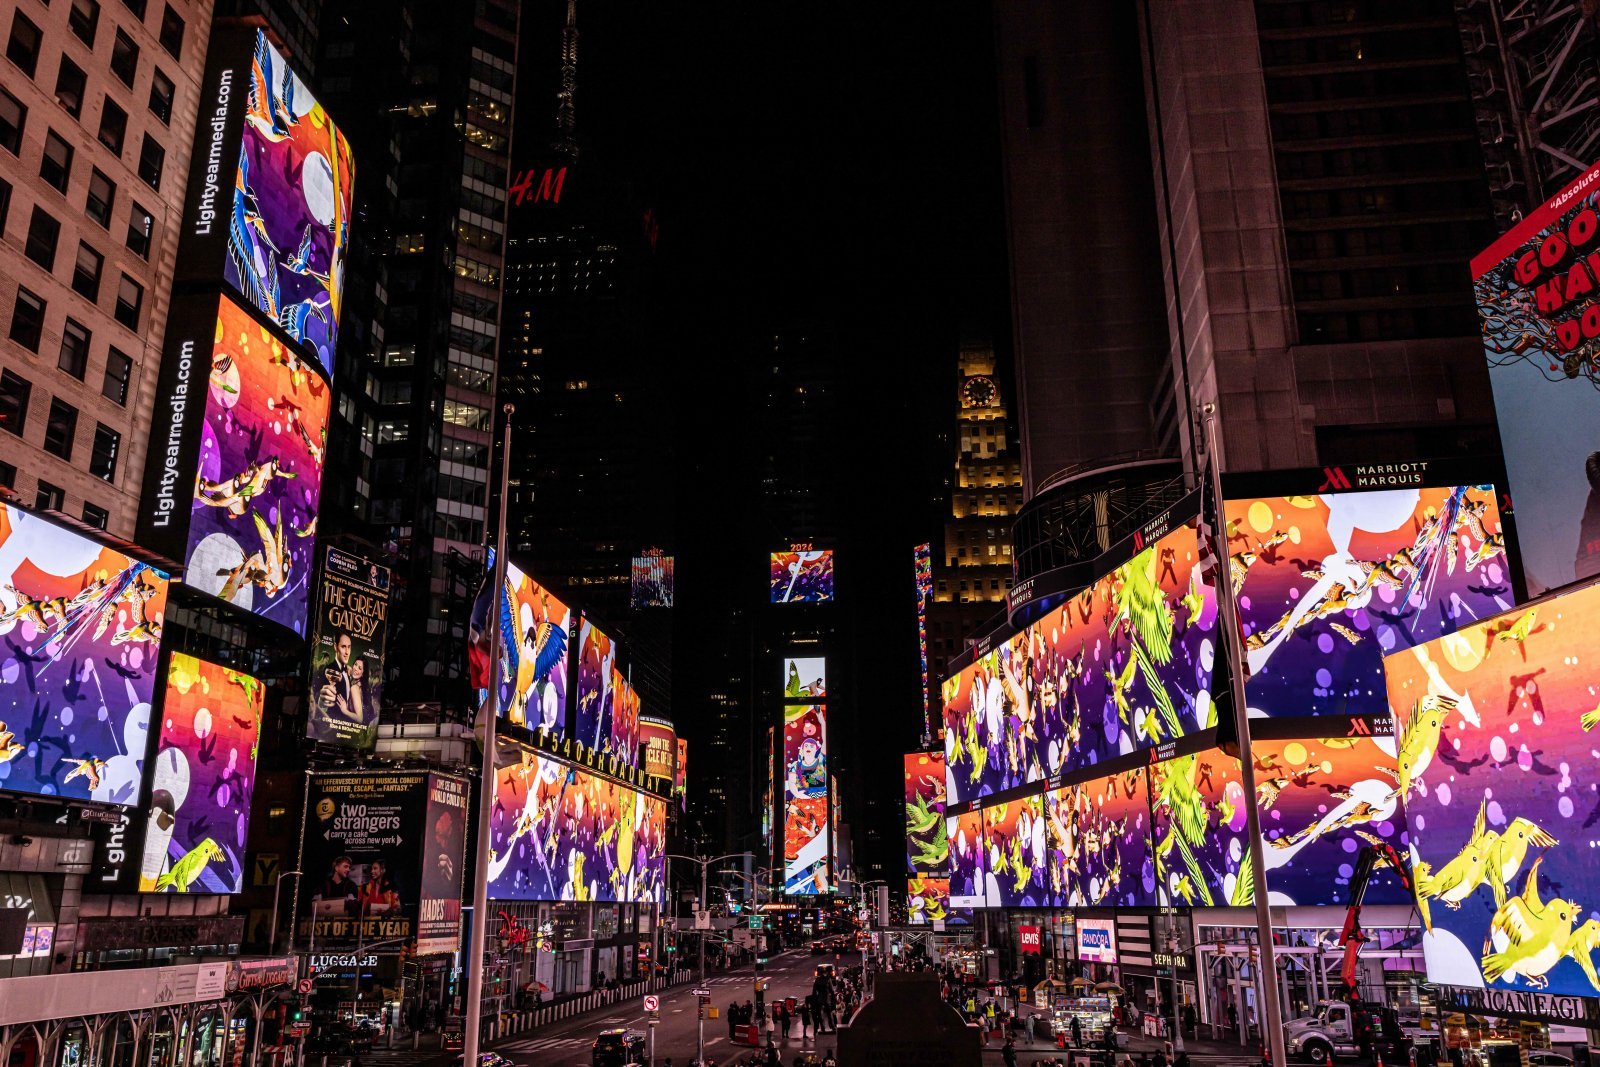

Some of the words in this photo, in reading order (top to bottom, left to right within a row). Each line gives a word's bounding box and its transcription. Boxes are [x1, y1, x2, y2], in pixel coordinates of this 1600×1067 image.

[195, 69, 233, 235] Lightyearmedia.com
[508, 167, 567, 206] H&M
[153, 340, 194, 527] Lightyearmedia.com
[1357, 462, 1428, 475] MARRIOTT
[1358, 474, 1421, 486] MARQUIS
[1144, 513, 1170, 534] MARRIOTT
[1145, 523, 1168, 544] MARQUIS
[324, 582, 346, 608] THE
[347, 592, 388, 621] GREAT
[328, 606, 379, 637] GATSBY
[537, 729, 584, 762] 1540
[586, 746, 660, 793] BROADWAY
[322, 785, 353, 793] LAUGHTER,
[341, 802, 367, 817] two
[333, 816, 400, 833] strangers
[330, 831, 347, 840] carry
[381, 836, 396, 845] york
[300, 921, 331, 937] BEST
[332, 921, 348, 936] OF
[351, 921, 375, 936] THE
[378, 921, 410, 936] YEAR
[311, 955, 378, 966] LUGGAGE
[1154, 954, 1186, 967] SEPHRA
